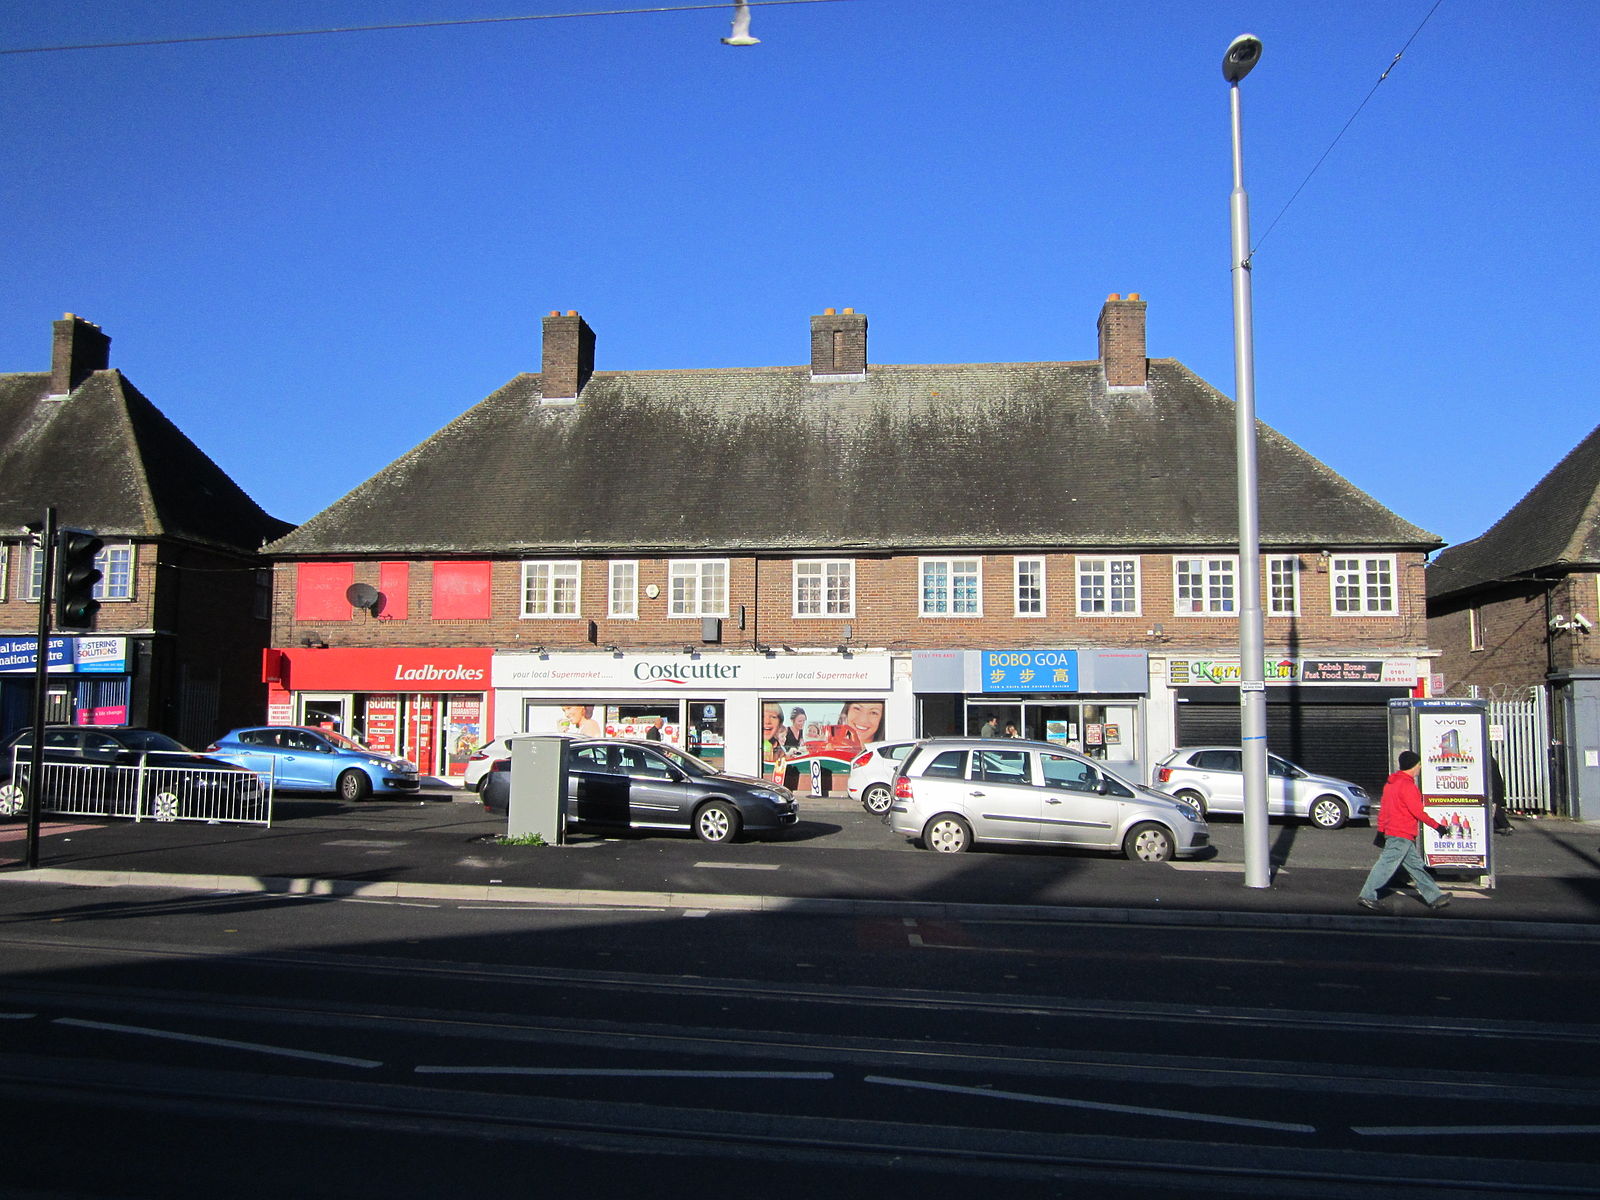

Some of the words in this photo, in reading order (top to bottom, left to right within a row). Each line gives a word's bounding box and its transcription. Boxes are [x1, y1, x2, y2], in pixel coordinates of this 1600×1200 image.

[77, 640, 117, 650] FOSTERING
[31, 652, 63, 663] ctre
[77, 648, 118, 658] SOLUTIONS
[989, 653, 1031, 666] BOBO
[1035, 653, 1068, 666] GOA
[634, 661, 741, 680] Costcutter
[1318, 663, 1342, 671] Kebab
[1343, 663, 1367, 671] House
[394, 664, 484, 681] Ladbrokes
[512, 671, 530, 679] your
[531, 670, 550, 679] local
[795, 671, 815, 680] local
[816, 671, 868, 680] Supermarket
[1322, 671, 1341, 679] Food
[1362, 671, 1380, 681] Away
[369, 697, 396, 709] SCORE
[1436, 781, 1469, 790] E-LIQUID
[1434, 841, 1455, 849] BERRY
[1457, 841, 1477, 849] BLAST
